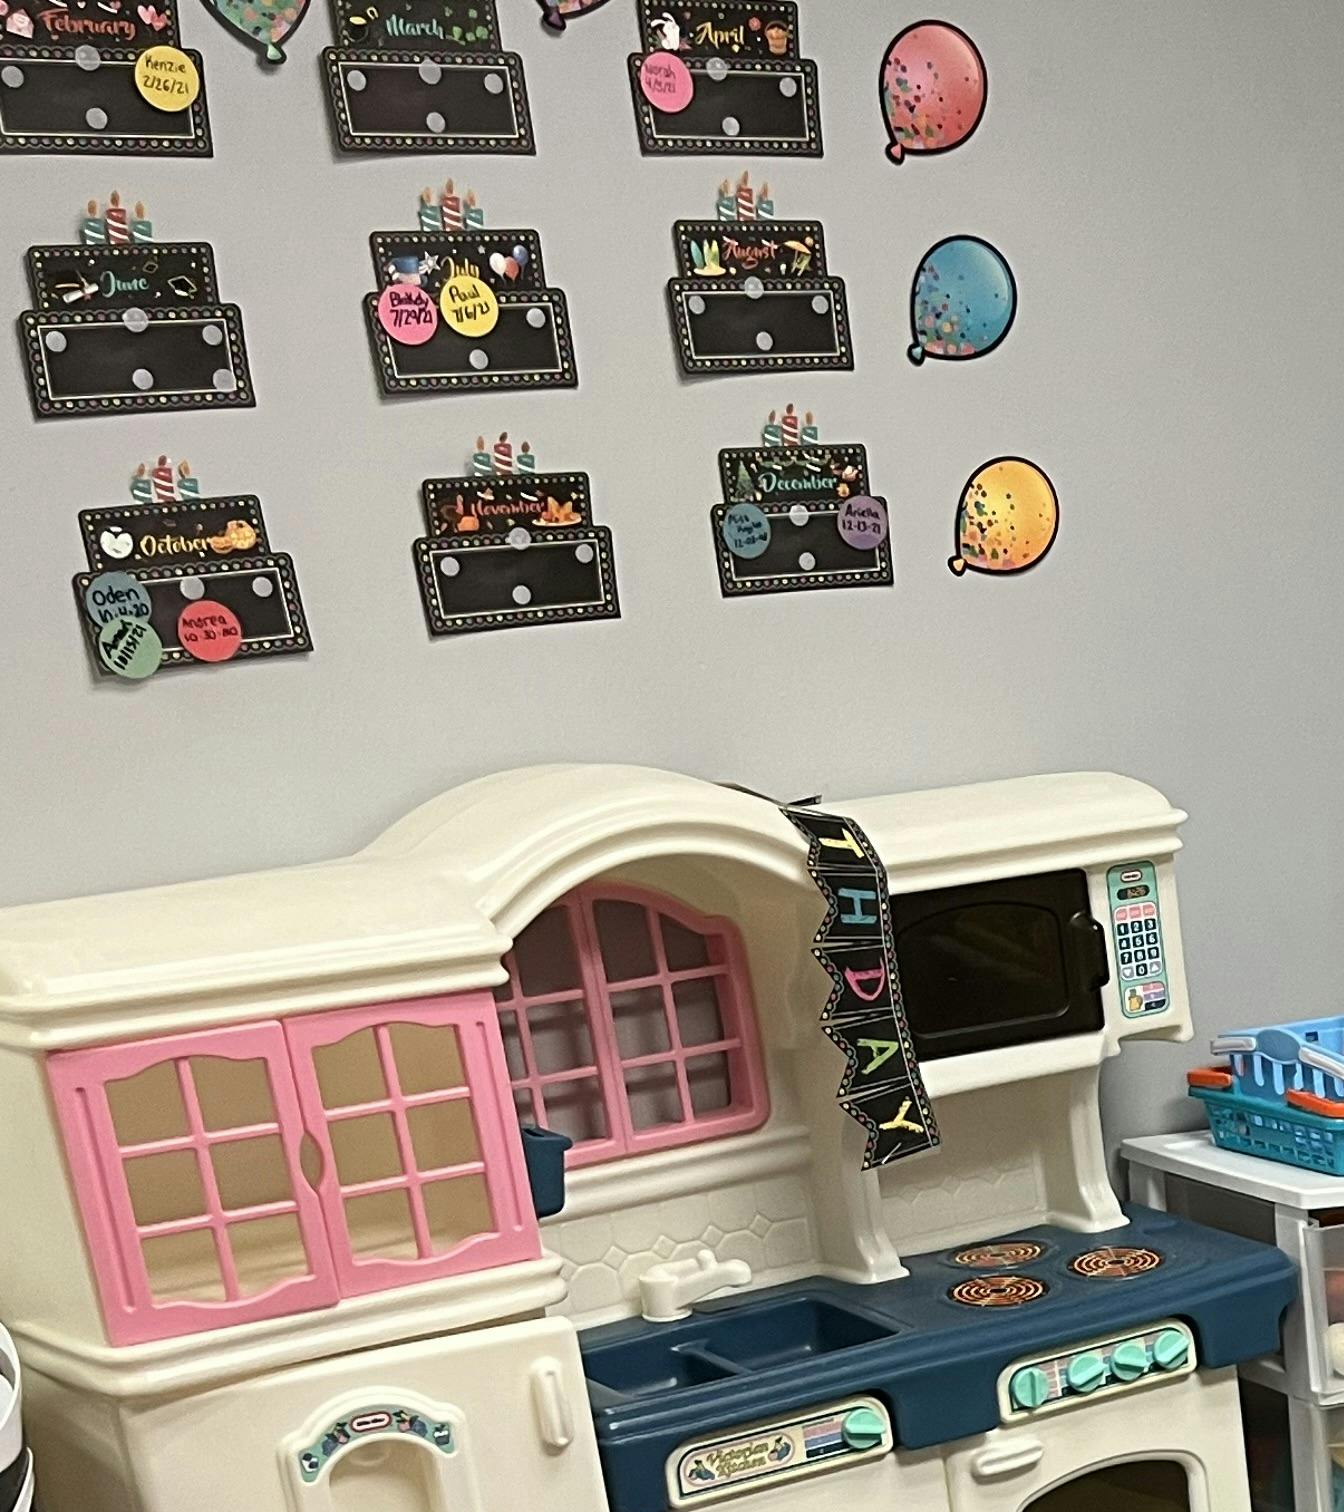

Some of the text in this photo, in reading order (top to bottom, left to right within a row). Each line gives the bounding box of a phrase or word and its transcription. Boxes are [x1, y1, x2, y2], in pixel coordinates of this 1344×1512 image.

[38, 8, 137, 41] February
[386, 13, 445, 40] March
[696, 21, 745, 49] April
[145, 54, 187, 74] Kenzie
[143, 75, 190, 95] 2/26/21
[721, 237, 777, 270] August
[100, 270, 150, 298] June
[757, 471, 837, 493] December
[470, 499, 545, 517] November
[139, 533, 210, 557] October
[92, 584, 140, 606] Oden
